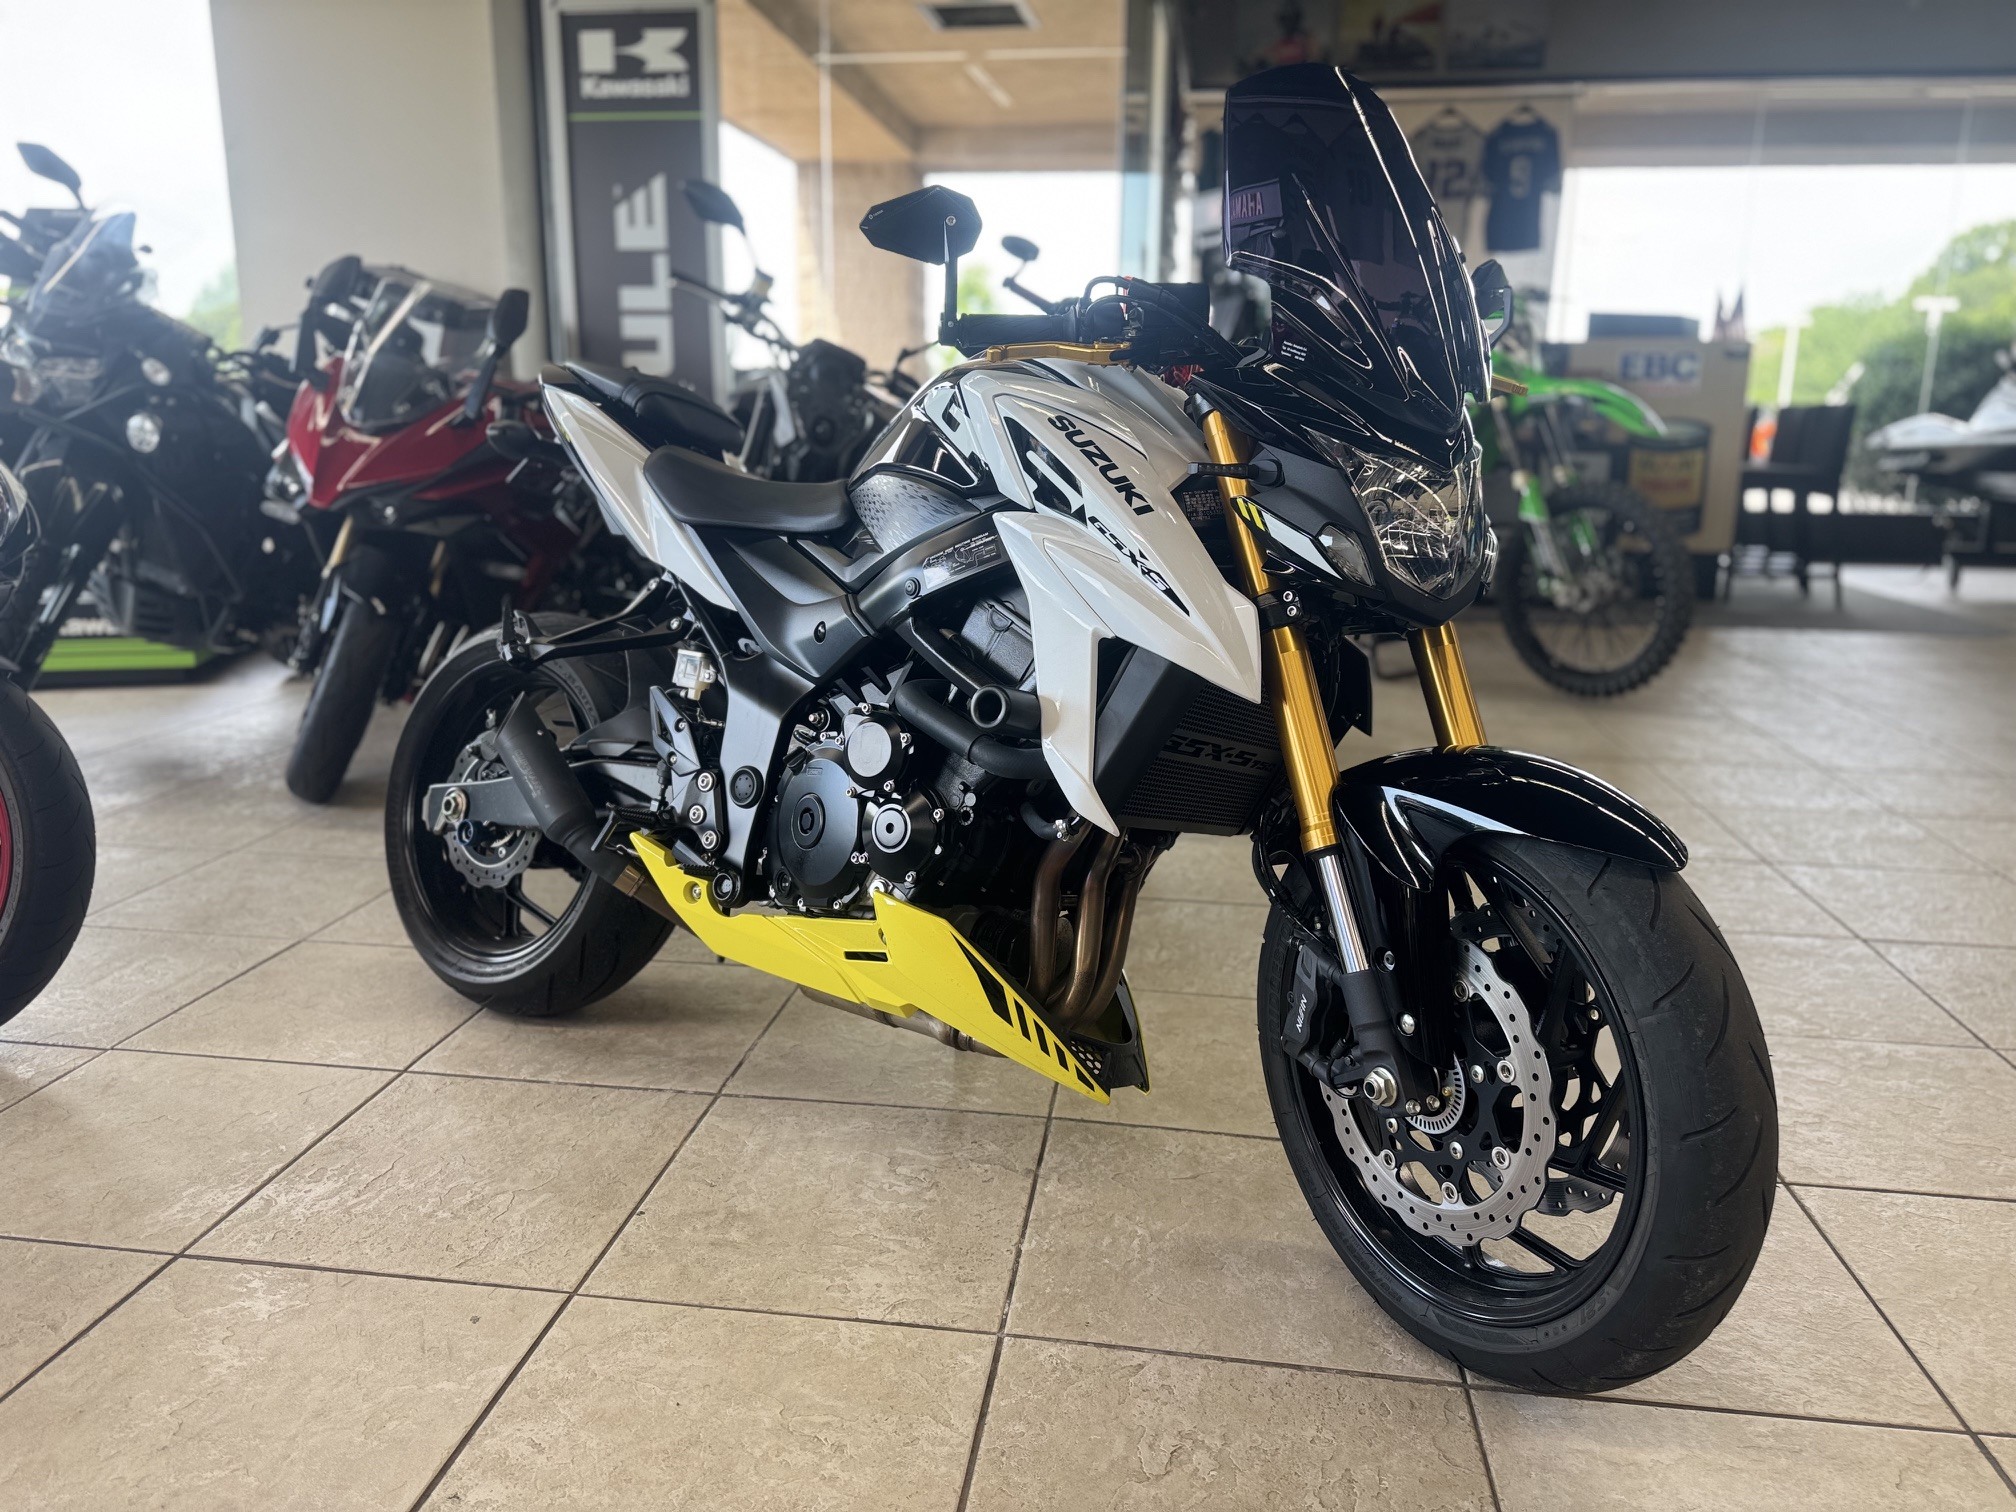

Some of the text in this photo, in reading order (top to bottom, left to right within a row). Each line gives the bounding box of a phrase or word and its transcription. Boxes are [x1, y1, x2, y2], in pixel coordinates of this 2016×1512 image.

[579, 76, 691, 98] Kawasaki
[1620, 353, 1698, 381] EBC
[1048, 415, 1155, 516] SUZUKI
